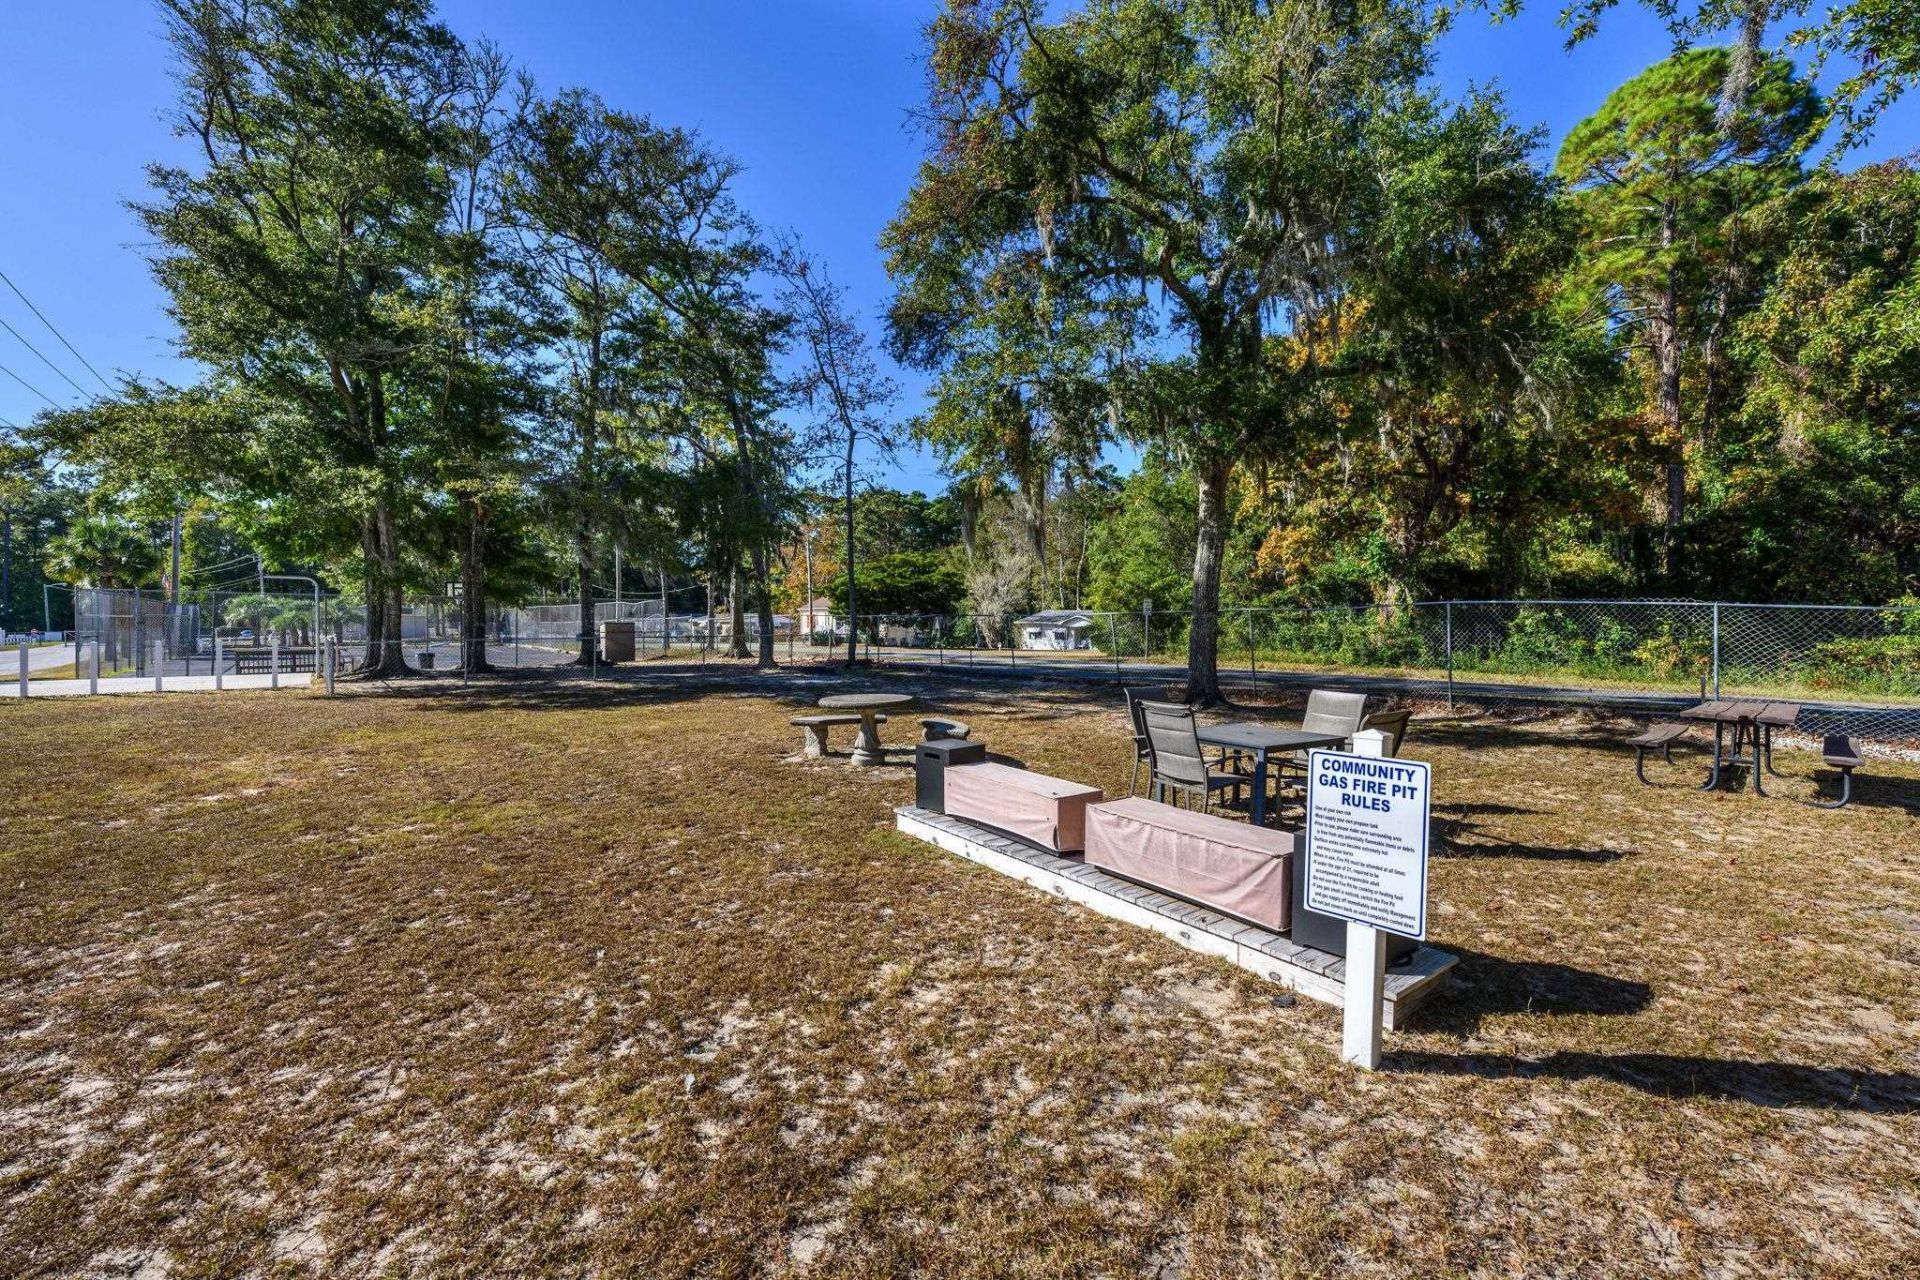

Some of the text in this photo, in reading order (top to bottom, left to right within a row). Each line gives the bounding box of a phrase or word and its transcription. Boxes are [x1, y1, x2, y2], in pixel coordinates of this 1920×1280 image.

[1322, 758, 1416, 782] COMMUNITY
[1319, 774, 1417, 800] GAS FIRE PIT
[1342, 793, 1390, 813] RULES
